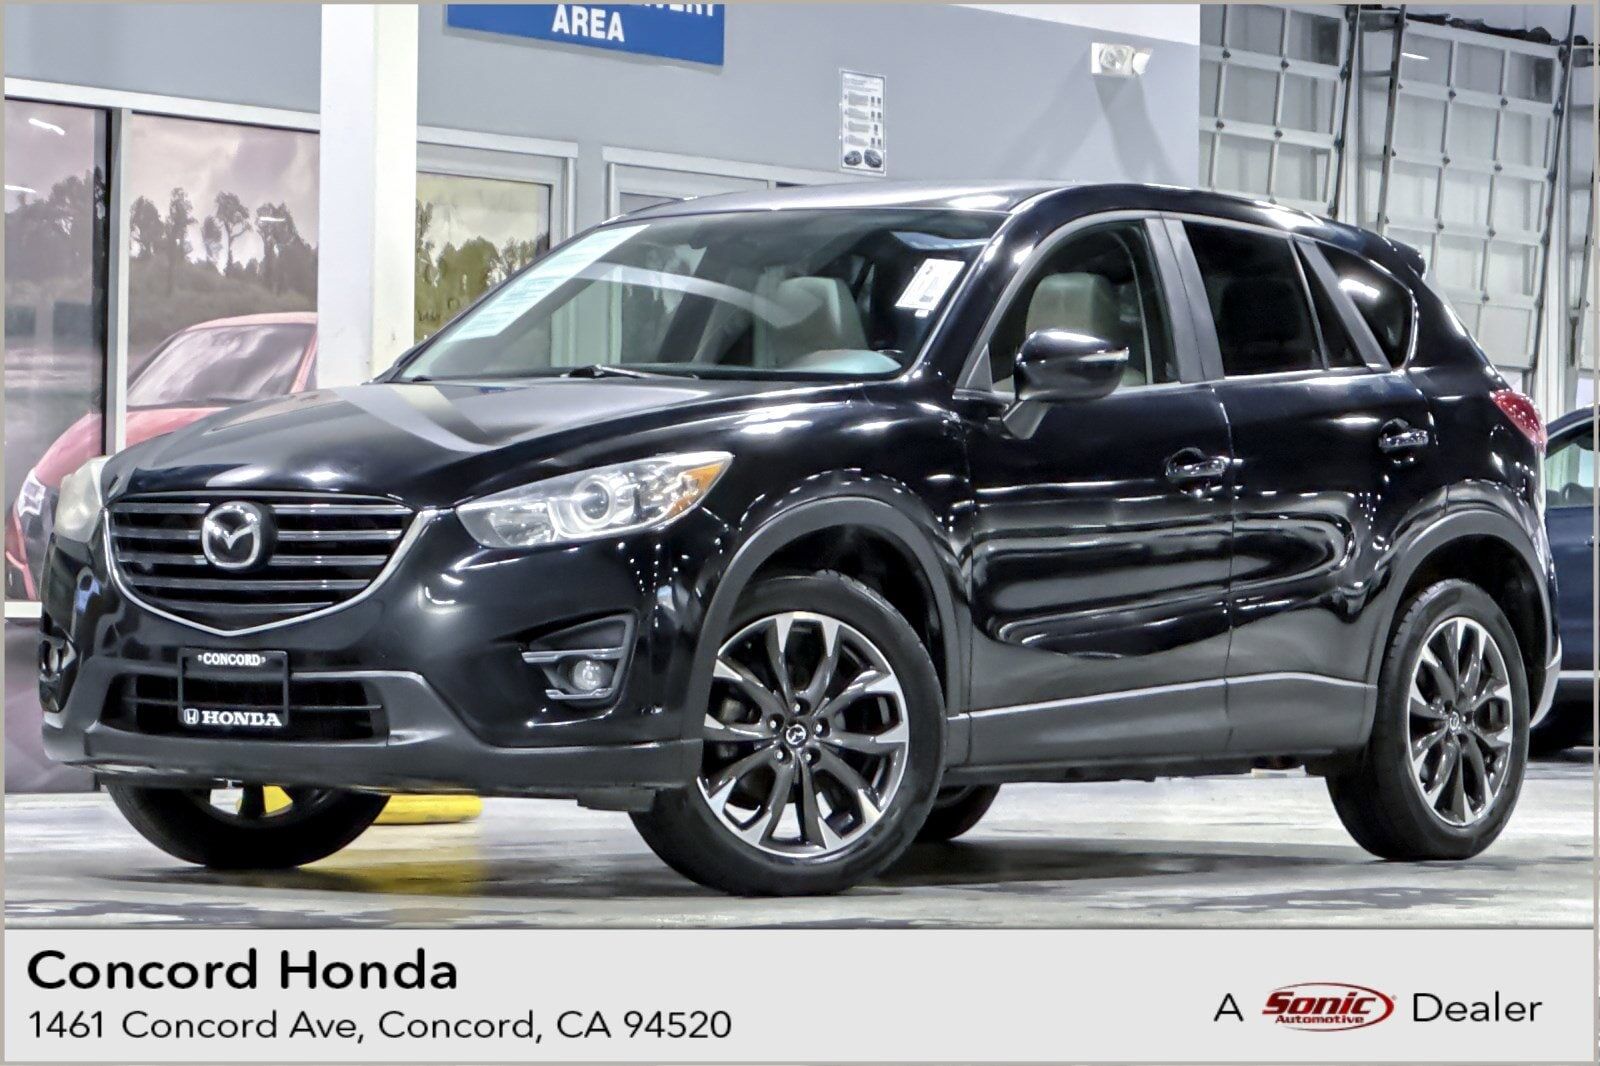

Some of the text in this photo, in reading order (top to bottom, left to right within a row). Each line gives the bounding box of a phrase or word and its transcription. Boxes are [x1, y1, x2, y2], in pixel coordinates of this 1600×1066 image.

[551, 5, 625, 42] AREA
[203, 653, 261, 666] CONCORD
[202, 711, 282, 726] HONDA
